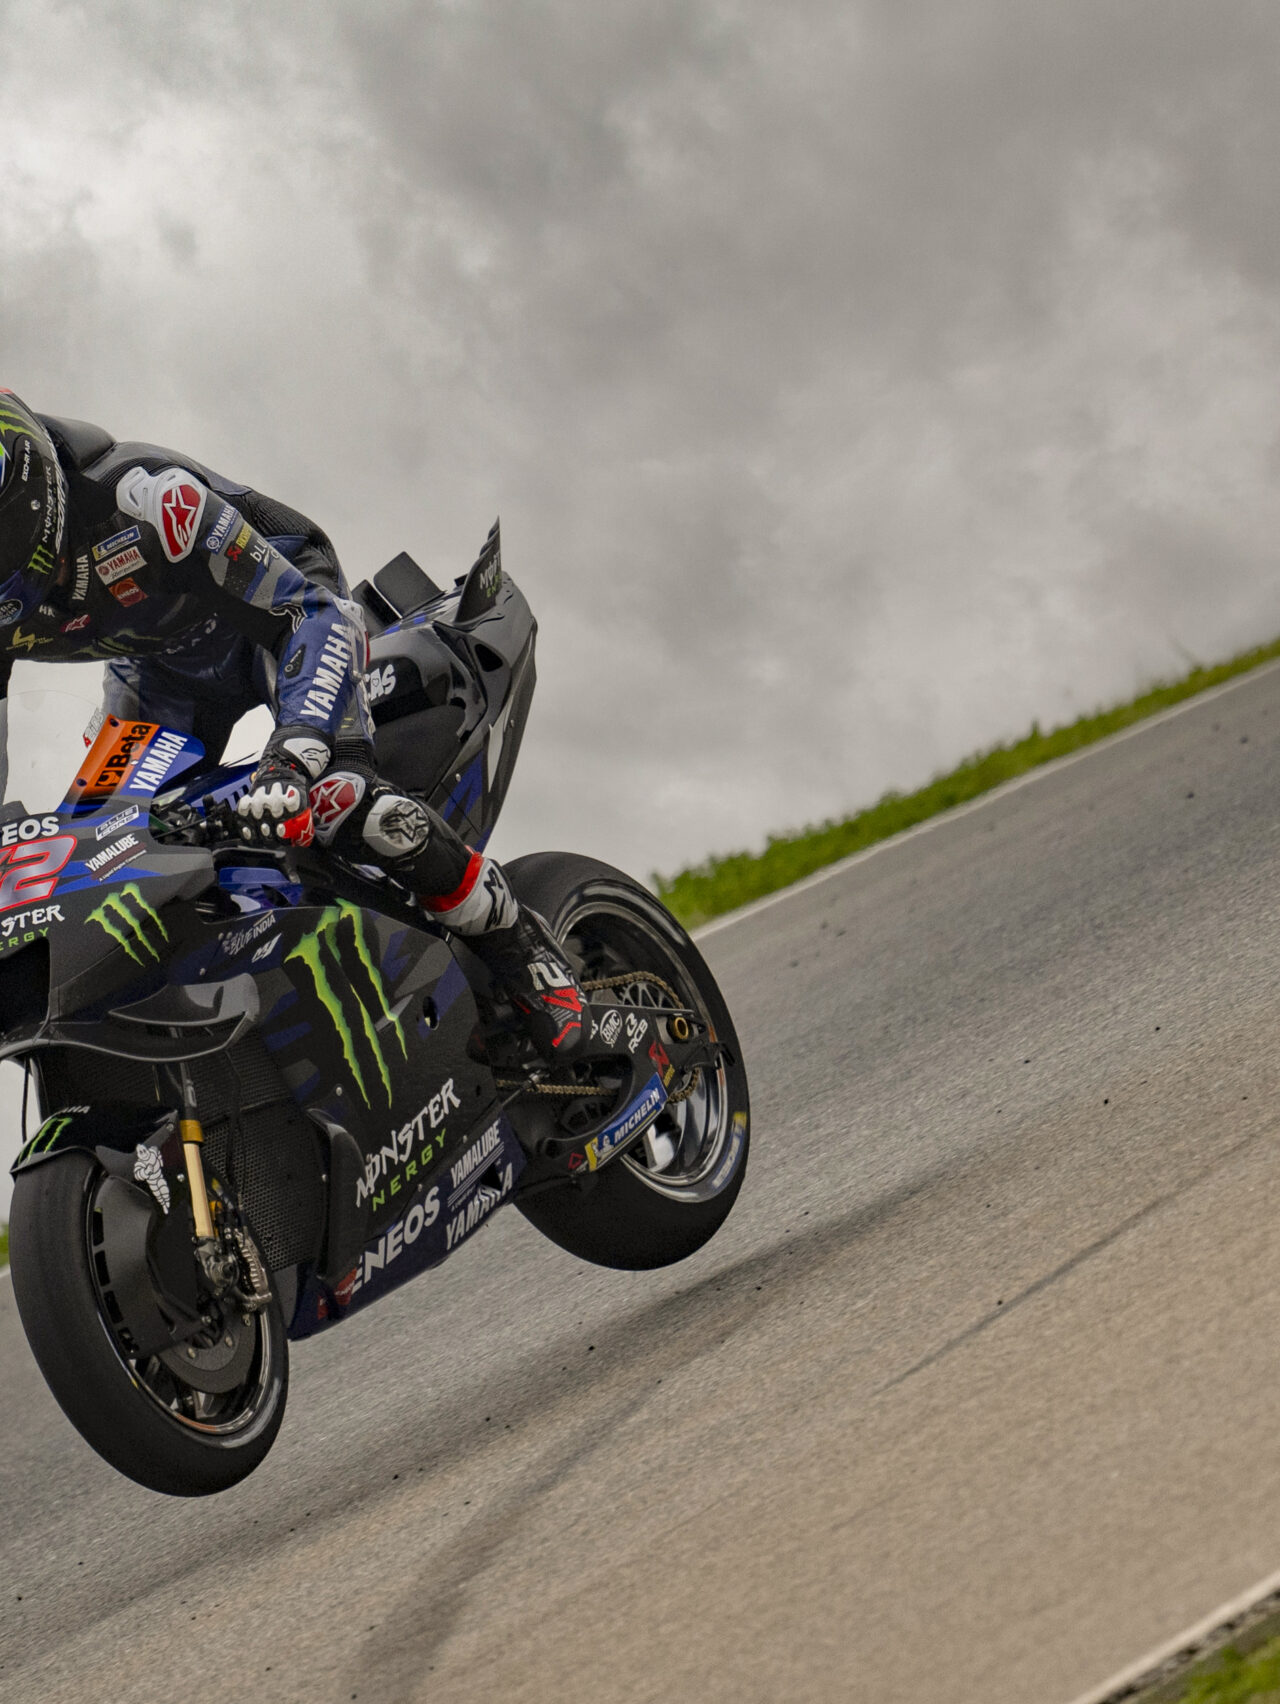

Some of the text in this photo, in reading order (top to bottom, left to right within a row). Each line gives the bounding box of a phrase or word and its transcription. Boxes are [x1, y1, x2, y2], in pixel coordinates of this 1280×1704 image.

[72, 554, 89, 600] YAMAHA
[107, 549, 140, 571] YAMAHA
[300, 622, 351, 720] YAMAHA
[129, 731, 188, 792] YAMAHA
[84, 832, 140, 872] YAMALUBE
[253, 914, 276, 939] INDIA
[602, 1011, 620, 1042] BMC
[628, 1018, 648, 1054] RCB
[614, 1087, 660, 1143] MICHELIN
[356, 1078, 461, 1208] MONSTER
[451, 1118, 501, 1189] YAMALUBE
[373, 1128, 446, 1212] NERGY
